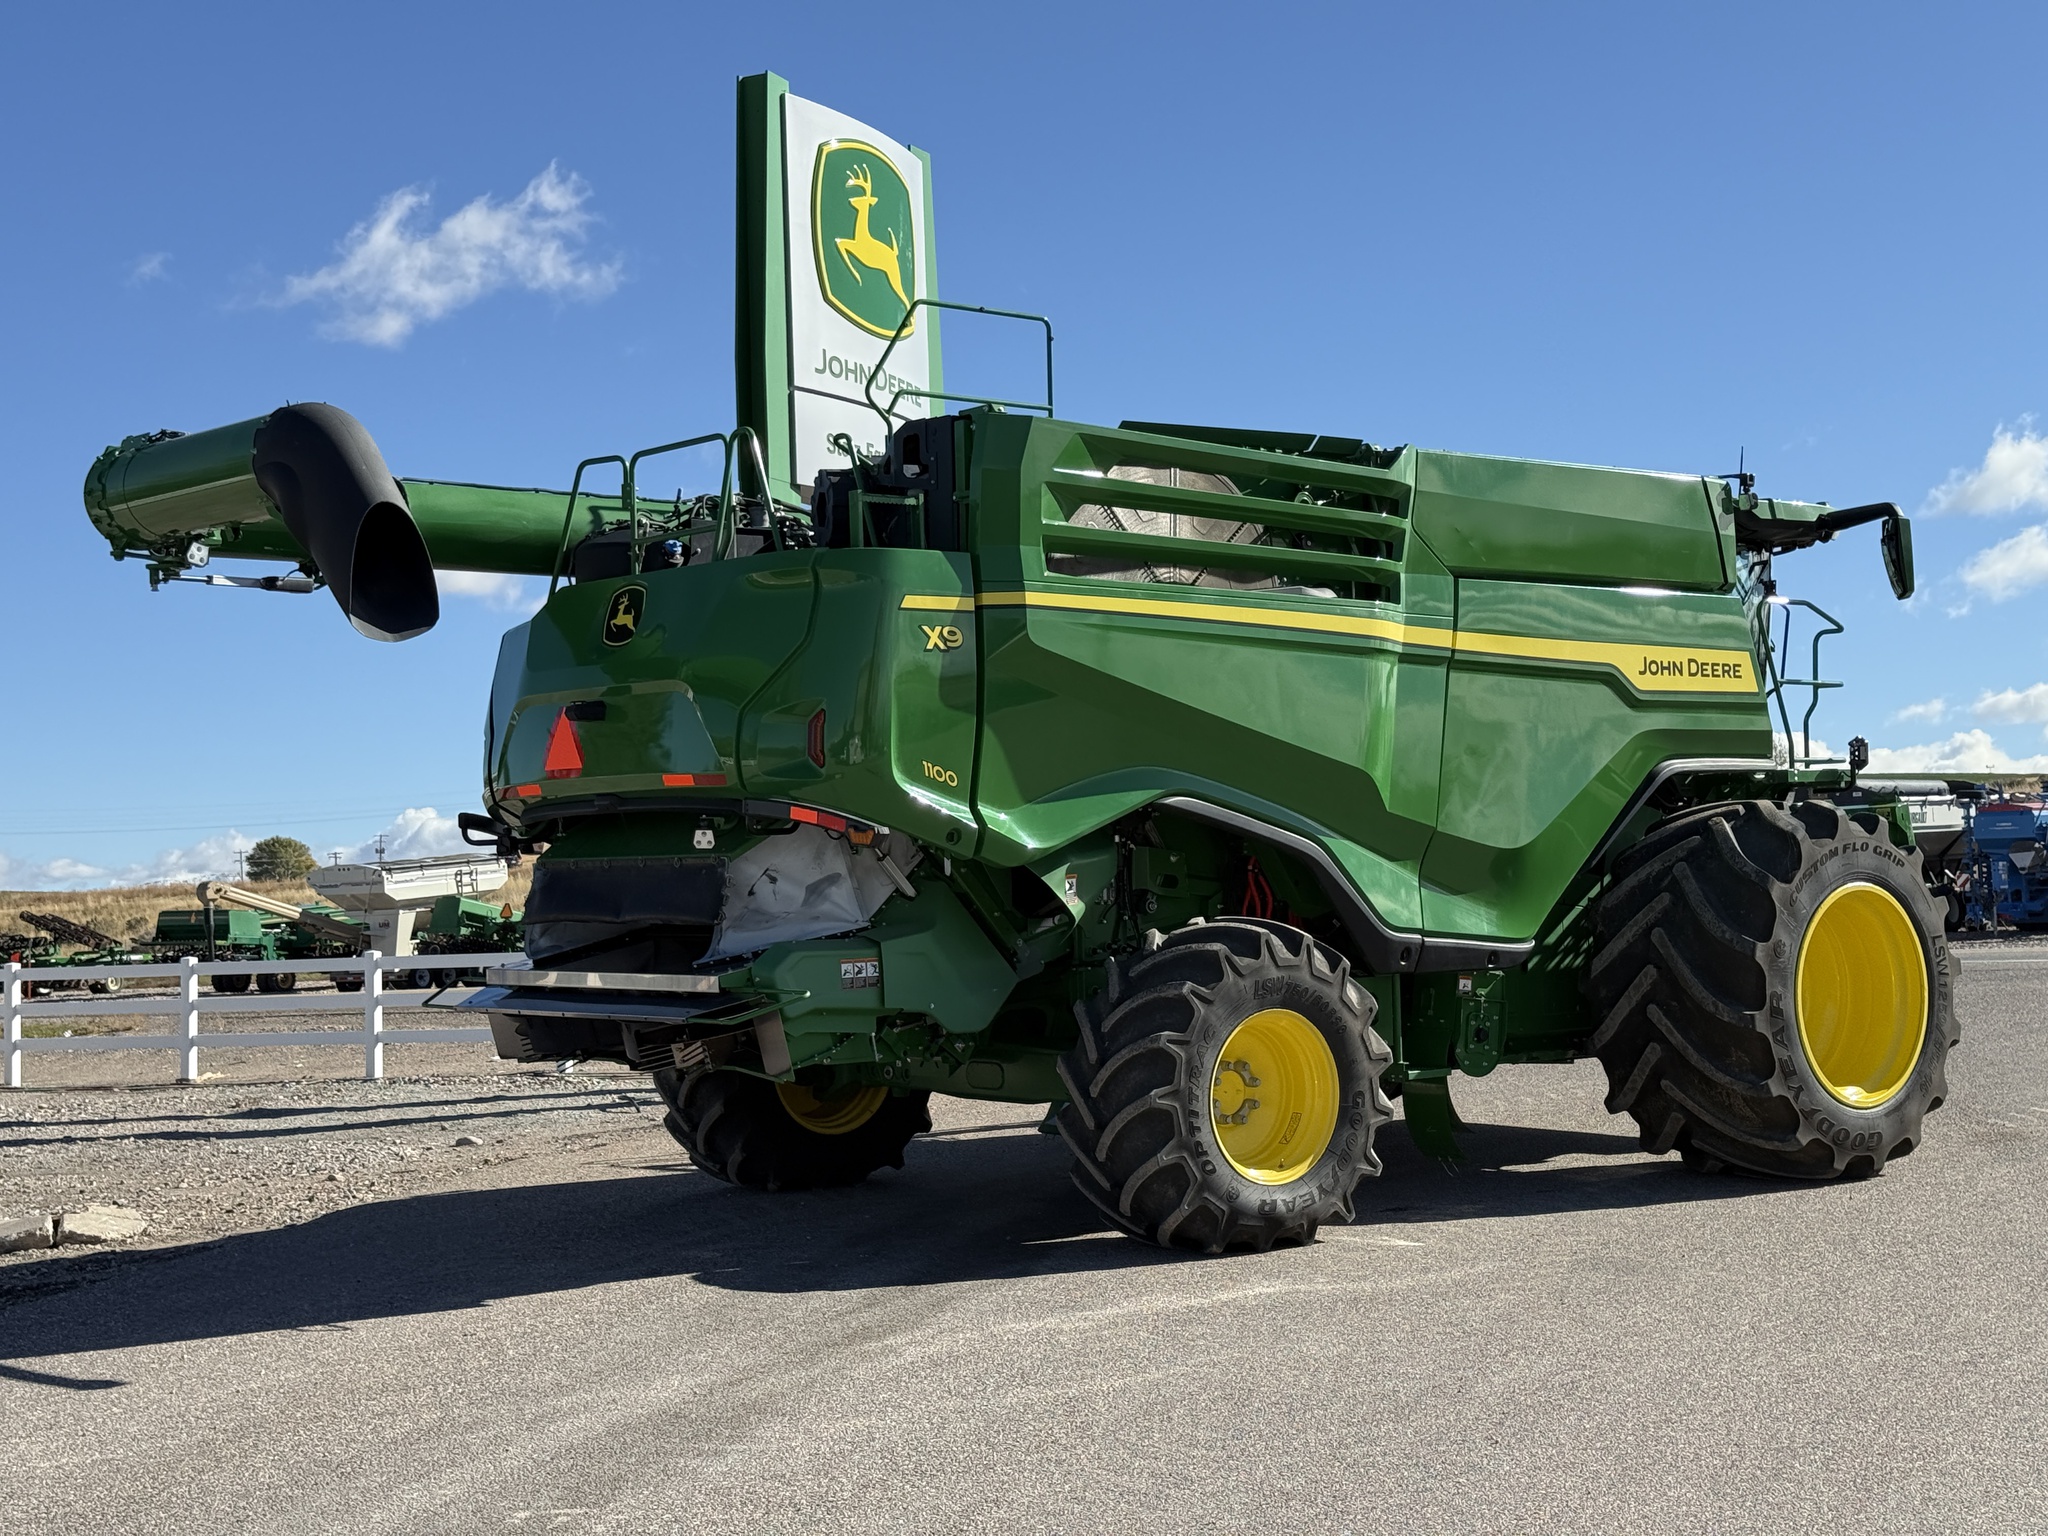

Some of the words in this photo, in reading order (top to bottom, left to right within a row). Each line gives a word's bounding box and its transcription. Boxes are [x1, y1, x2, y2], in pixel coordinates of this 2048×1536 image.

[814, 348, 872, 385] JOHN
[918, 624, 964, 653] X9
[1638, 656, 1683, 677] JOHN
[1687, 658, 1743, 679] DEERE
[921, 759, 959, 788] 1100
[1842, 841, 1870, 855] FLO
[1872, 844, 1906, 869] GRIP
[1769, 990, 1884, 1151] GOODYEAR
[1187, 1023, 1217, 1177] OPTITRAC
[1257, 1090, 1366, 1215] GOODYEAR
